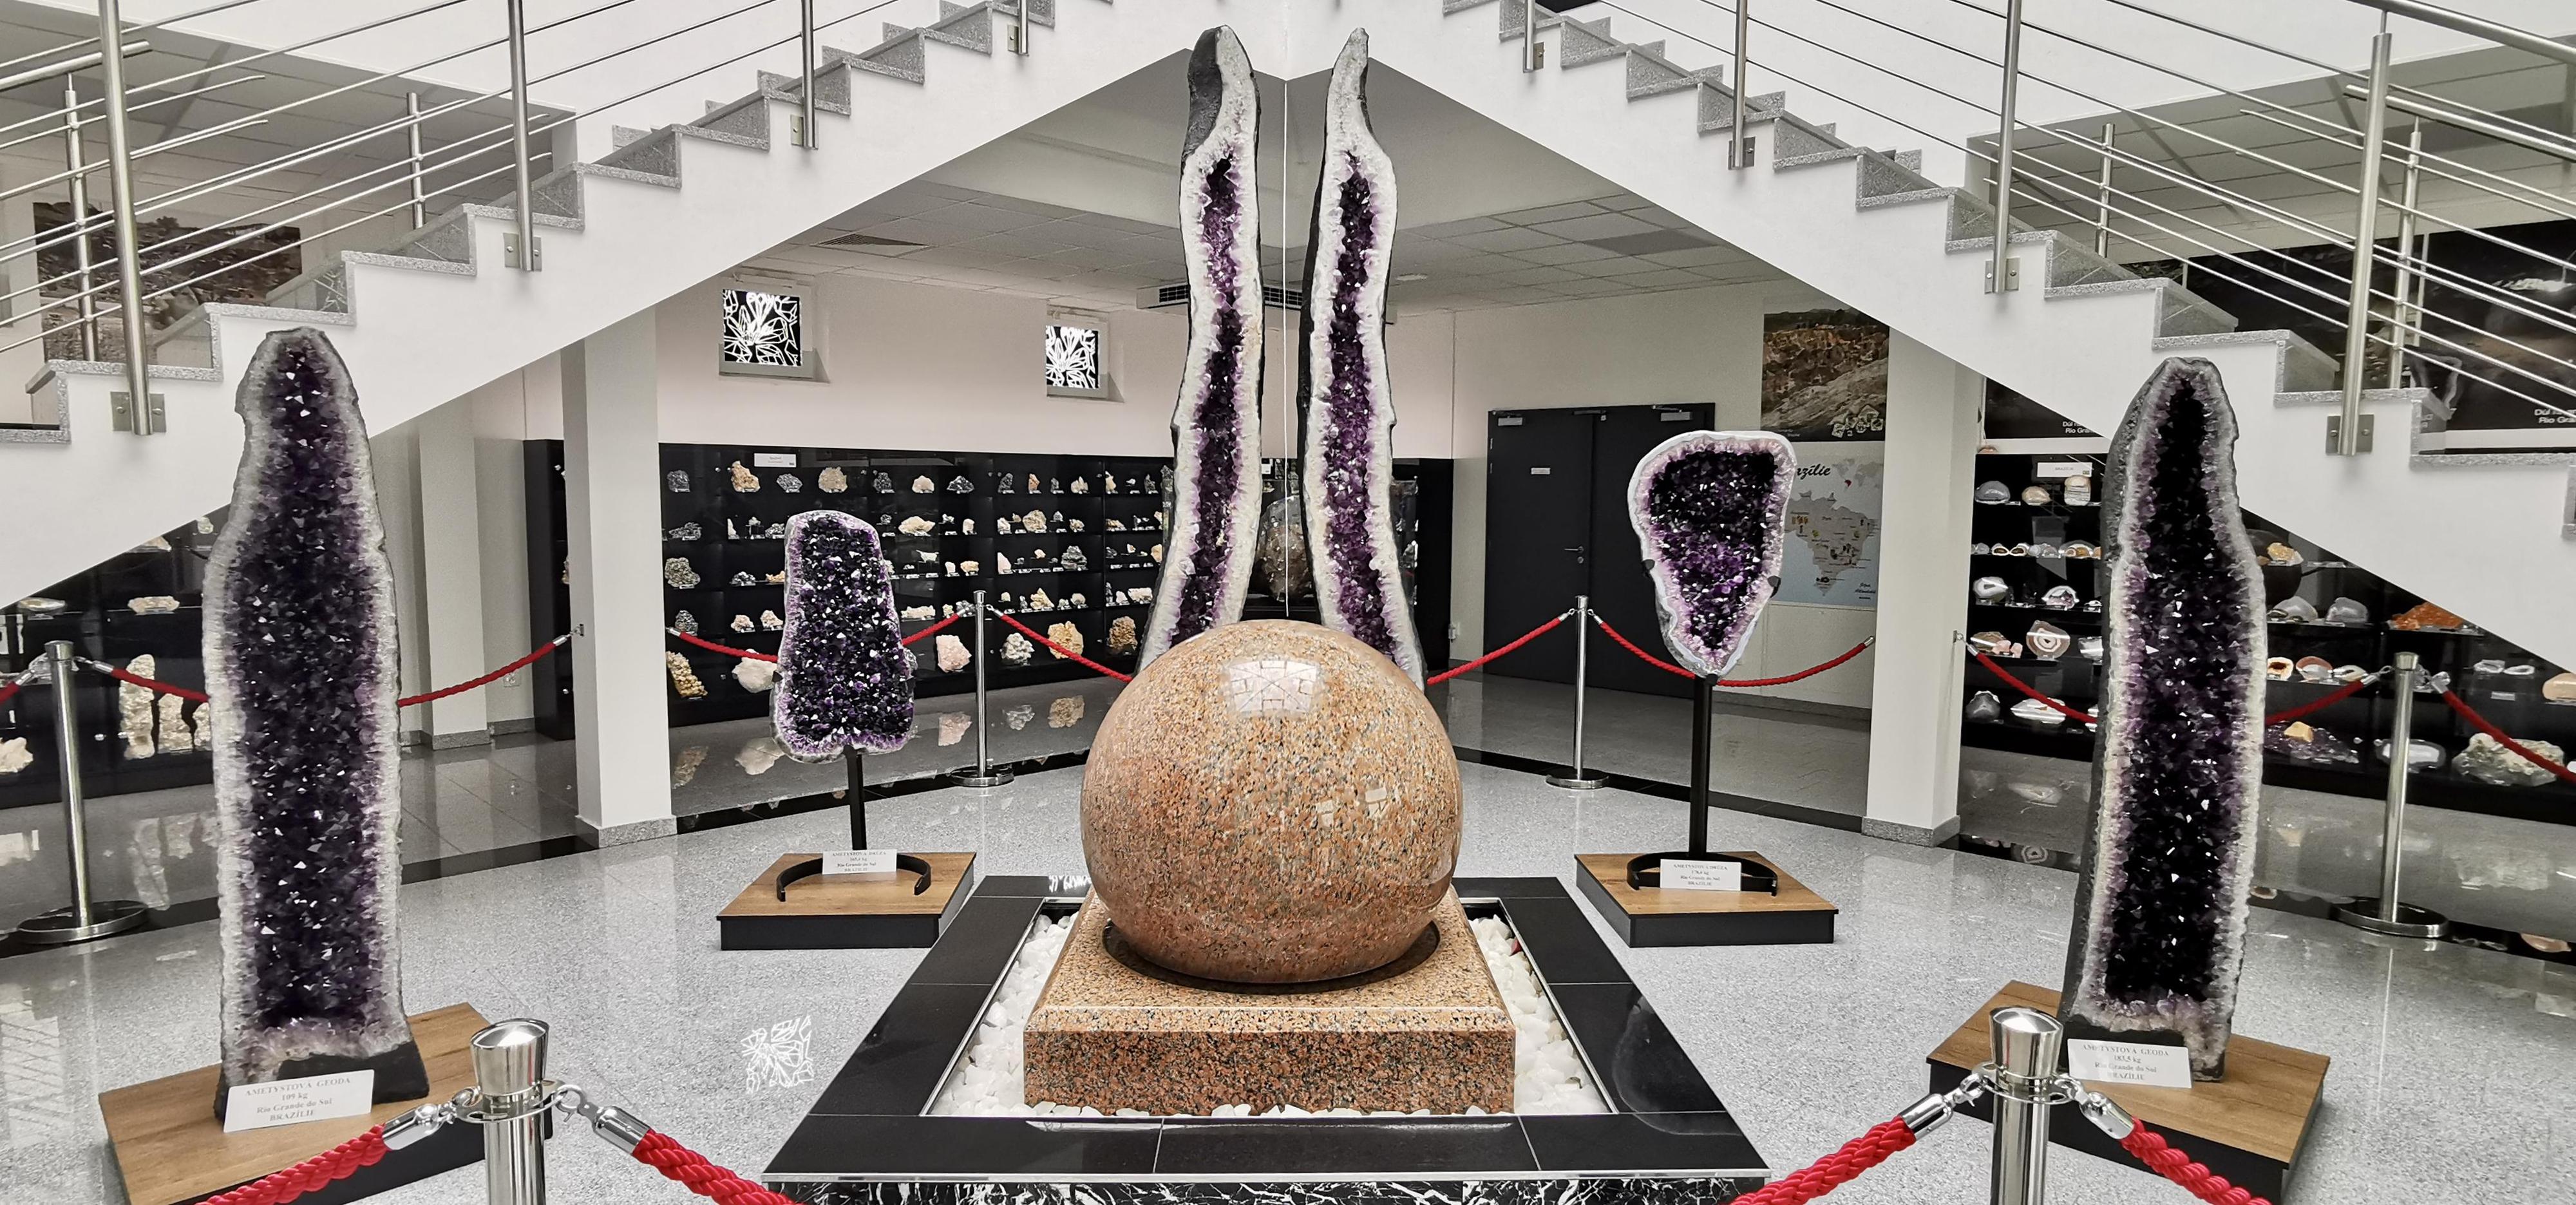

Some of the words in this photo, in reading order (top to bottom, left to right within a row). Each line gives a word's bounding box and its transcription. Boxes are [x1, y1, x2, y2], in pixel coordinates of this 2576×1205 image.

[2141, 1048, 2169, 1056] GEODA
[2107, 1072, 2144, 1080] RAZÍLIE
[317, 1077, 351, 1087] GEODA
[273, 1102, 305, 1112] Grande
